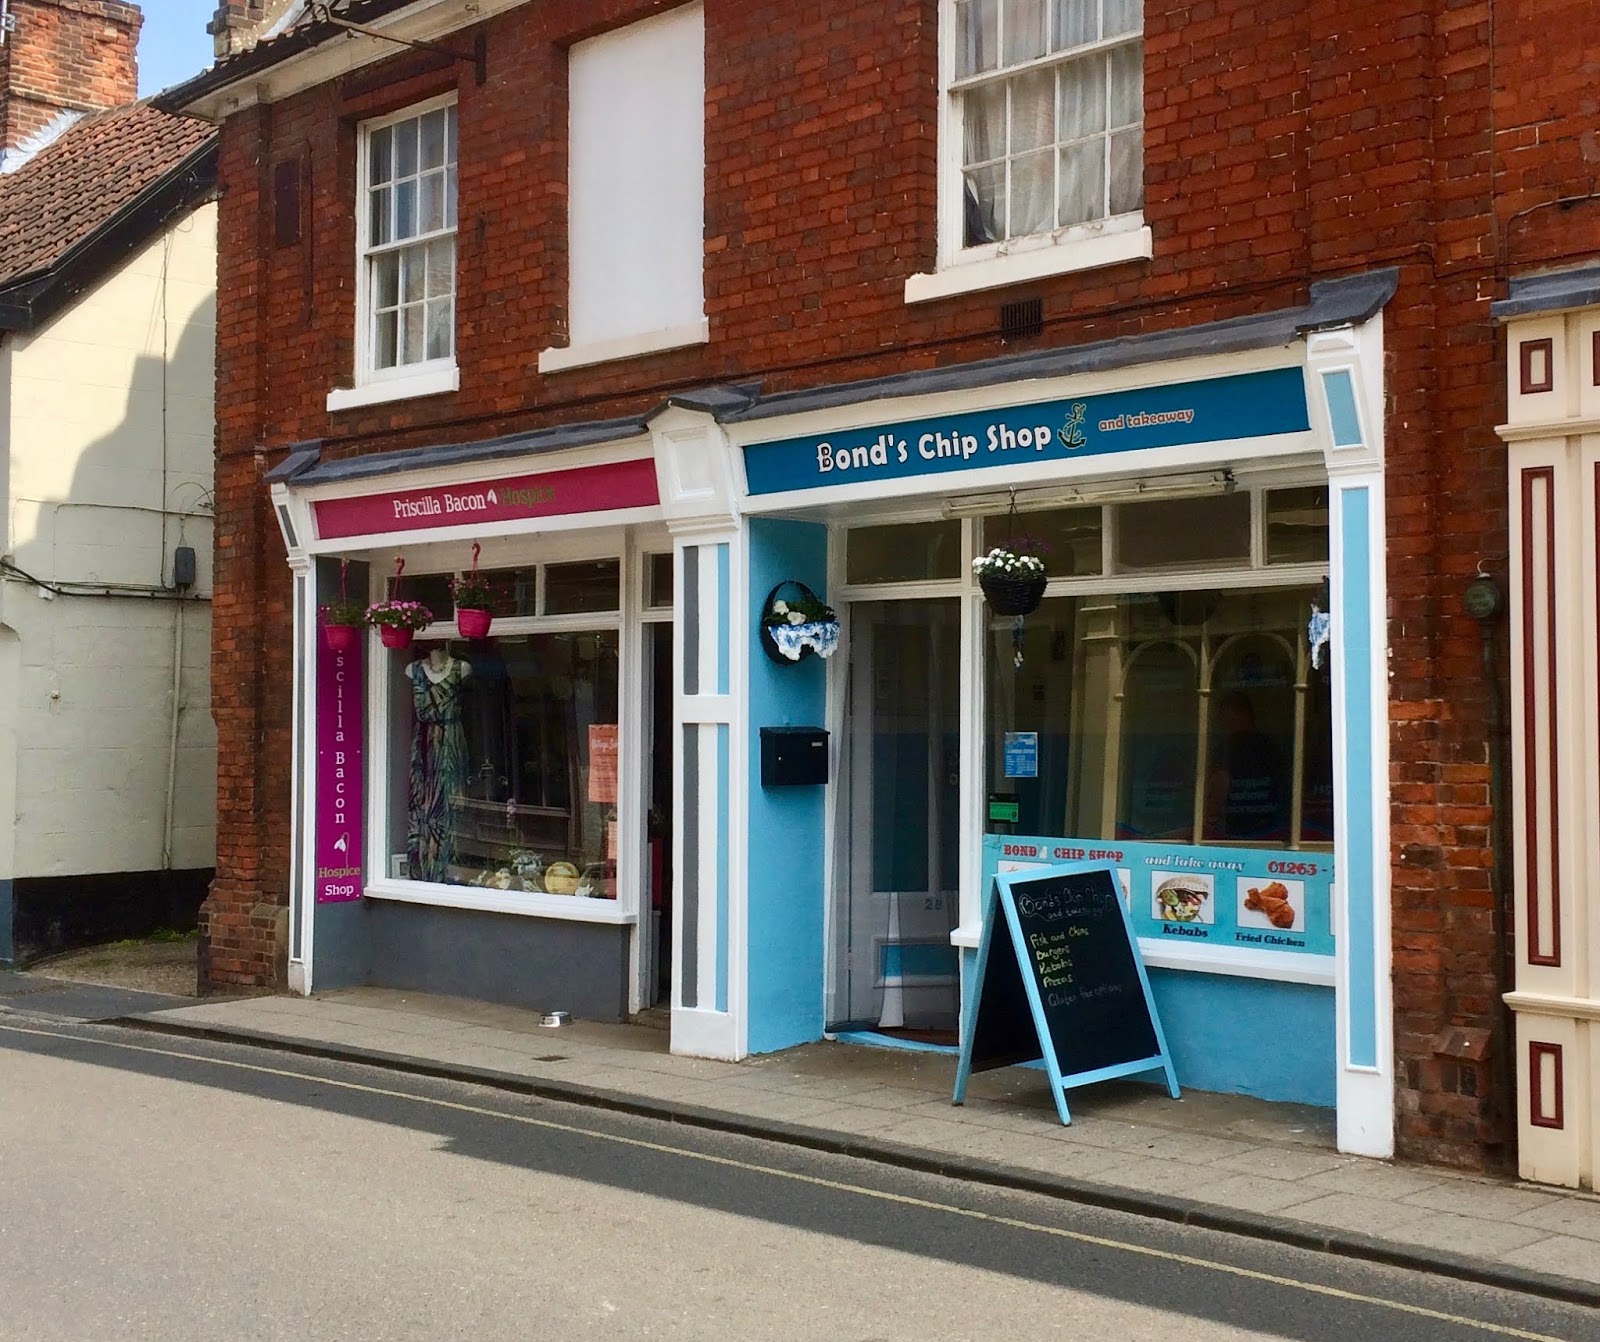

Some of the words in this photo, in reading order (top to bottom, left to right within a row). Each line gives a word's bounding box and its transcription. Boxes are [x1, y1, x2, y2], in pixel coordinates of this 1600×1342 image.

[1098, 414, 1125, 431] and
[1126, 409, 1194, 429] takeaway
[817, 434, 908, 472] Bond's
[918, 431, 977, 460] Chip
[987, 424, 1052, 452] Shop
[393, 496, 442, 518] Priscilla
[444, 494, 487, 513] Bacon
[501, 487, 555, 508] Hospice
[1054, 848, 1085, 860] CHIP
[1089, 849, 1123, 862] SHOP
[1145, 855, 1171, 866] and
[1208, 859, 1245, 872] away
[1268, 861, 1317, 876] 01263
[319, 866, 361, 879] Hospice
[325, 884, 354, 897] Shop
[1163, 924, 1208, 937] Kebabs
[1235, 932, 1262, 943] Fried
[1264, 935, 1305, 947] Chicken
